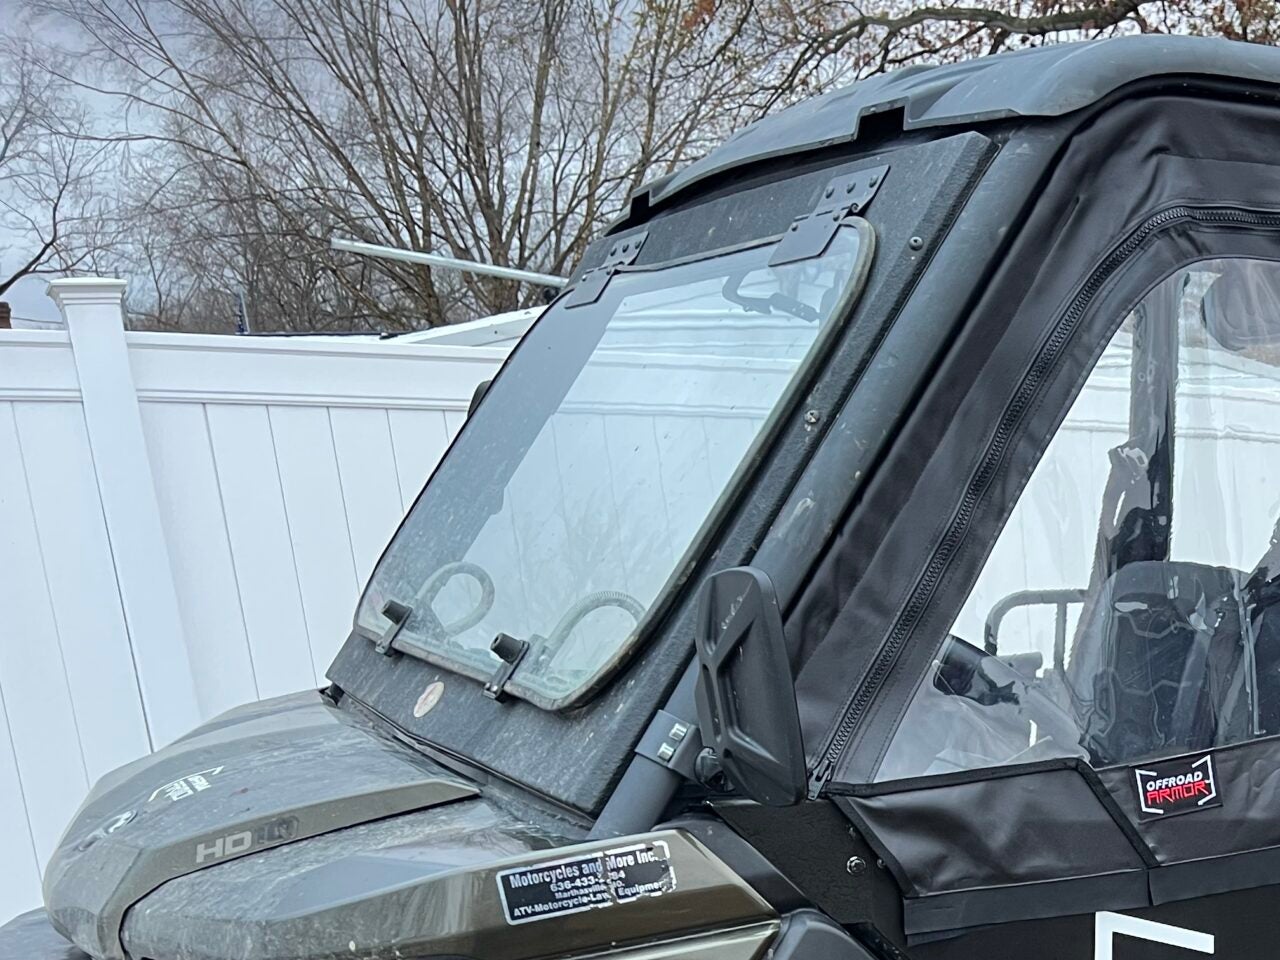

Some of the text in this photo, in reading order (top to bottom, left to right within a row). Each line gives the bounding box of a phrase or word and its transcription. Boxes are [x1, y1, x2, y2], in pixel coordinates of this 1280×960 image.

[1146, 771, 1203, 791] OFFROAD
[1146, 781, 1209, 805] ARMOR
[509, 851, 658, 888] Motorcycles and More Inc.
[514, 892, 615, 917] ATV-Motorcycle-Law
